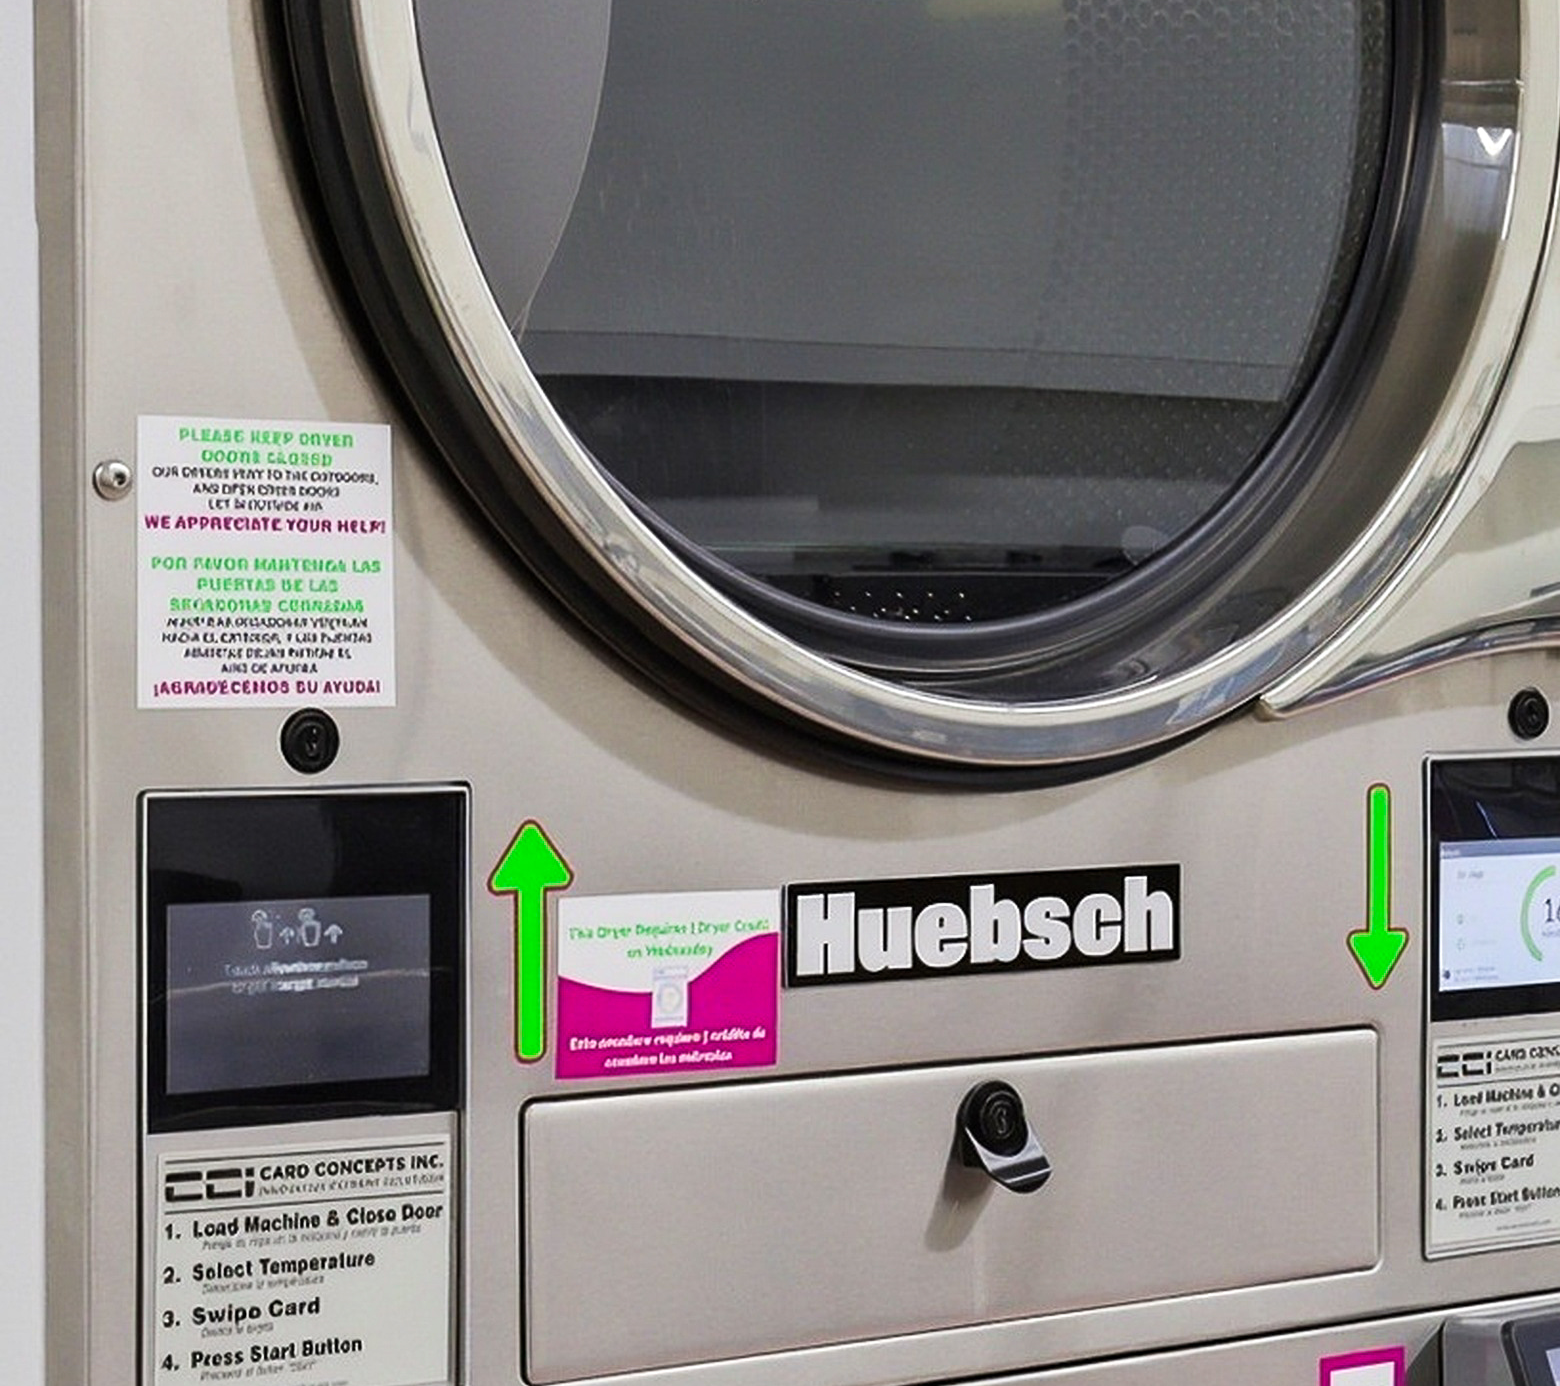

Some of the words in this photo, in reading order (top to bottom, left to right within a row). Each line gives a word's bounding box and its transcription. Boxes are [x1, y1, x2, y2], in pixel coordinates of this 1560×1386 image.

[180, 428, 245, 443] PLEASE
[144, 515, 170, 529] WE
[176, 516, 282, 531] APPRECIATE
[287, 518, 331, 532] YOUR
[338, 520, 386, 533] HELP!
[797, 875, 1173, 975] Huebsch
[1454, 1092, 1482, 1106] Load
[1454, 1125, 1491, 1141] Select
[260, 1166, 309, 1181] CARD
[315, 1156, 406, 1179] CONCEPTS
[411, 1155, 444, 1169] INC.
[1501, 1154, 1534, 1170] Card
[165, 1224, 181, 1240] 1.
[193, 1220, 238, 1238] Load
[245, 1213, 320, 1233] Machine
[327, 1210, 339, 1227] &
[347, 1208, 396, 1225] Close
[402, 1204, 443, 1220] Door
[163, 1267, 181, 1284] 2.
[193, 1261, 253, 1281] Select
[259, 1252, 375, 1276] Temperature
[163, 1311, 180, 1328] 3.
[192, 1304, 261, 1326] Swipe
[269, 1297, 320, 1317] Card
[161, 1355, 180, 1371] 4.
[191, 1349, 243, 1368] Press
[251, 1343, 295, 1362] Start
[303, 1338, 362, 1358] Button
